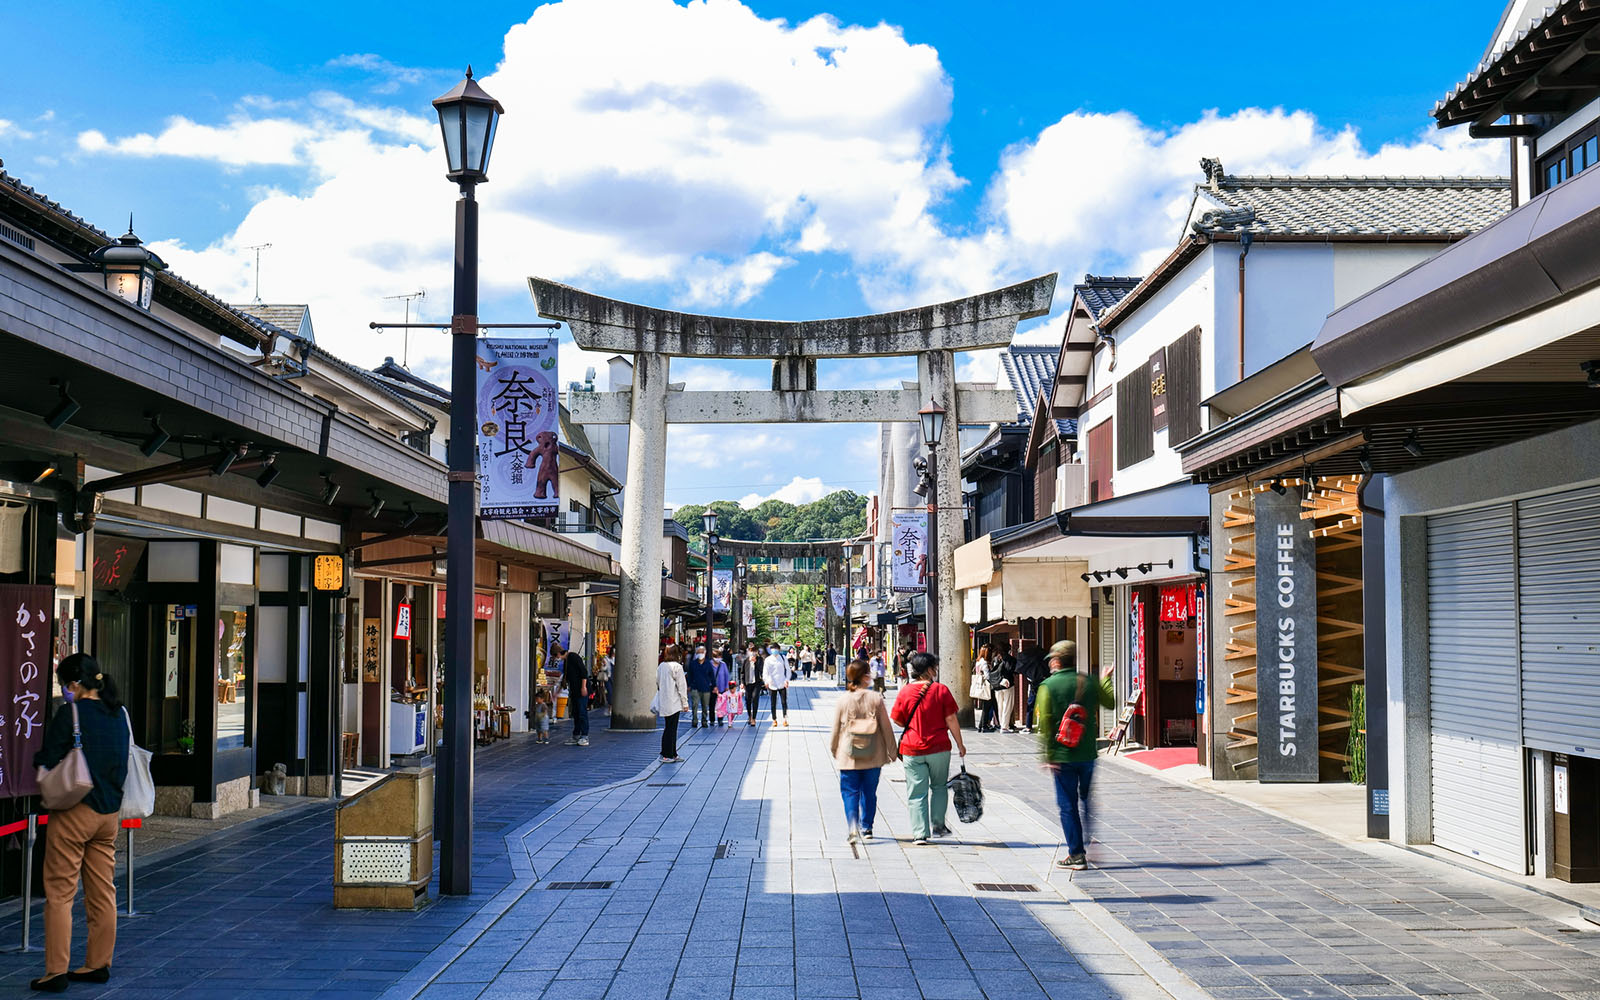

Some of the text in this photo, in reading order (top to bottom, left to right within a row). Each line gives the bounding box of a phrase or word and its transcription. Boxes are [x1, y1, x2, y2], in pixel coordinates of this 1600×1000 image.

[495, 351, 540, 359] 九州国立博物館
[492, 370, 542, 457] 奈良
[510, 451, 525, 485] 大発掘
[899, 527, 921, 566] 奈良
[13, 602, 46, 739] かさの家
[1277, 524, 1297, 757] STARBUCKS COFFEE
